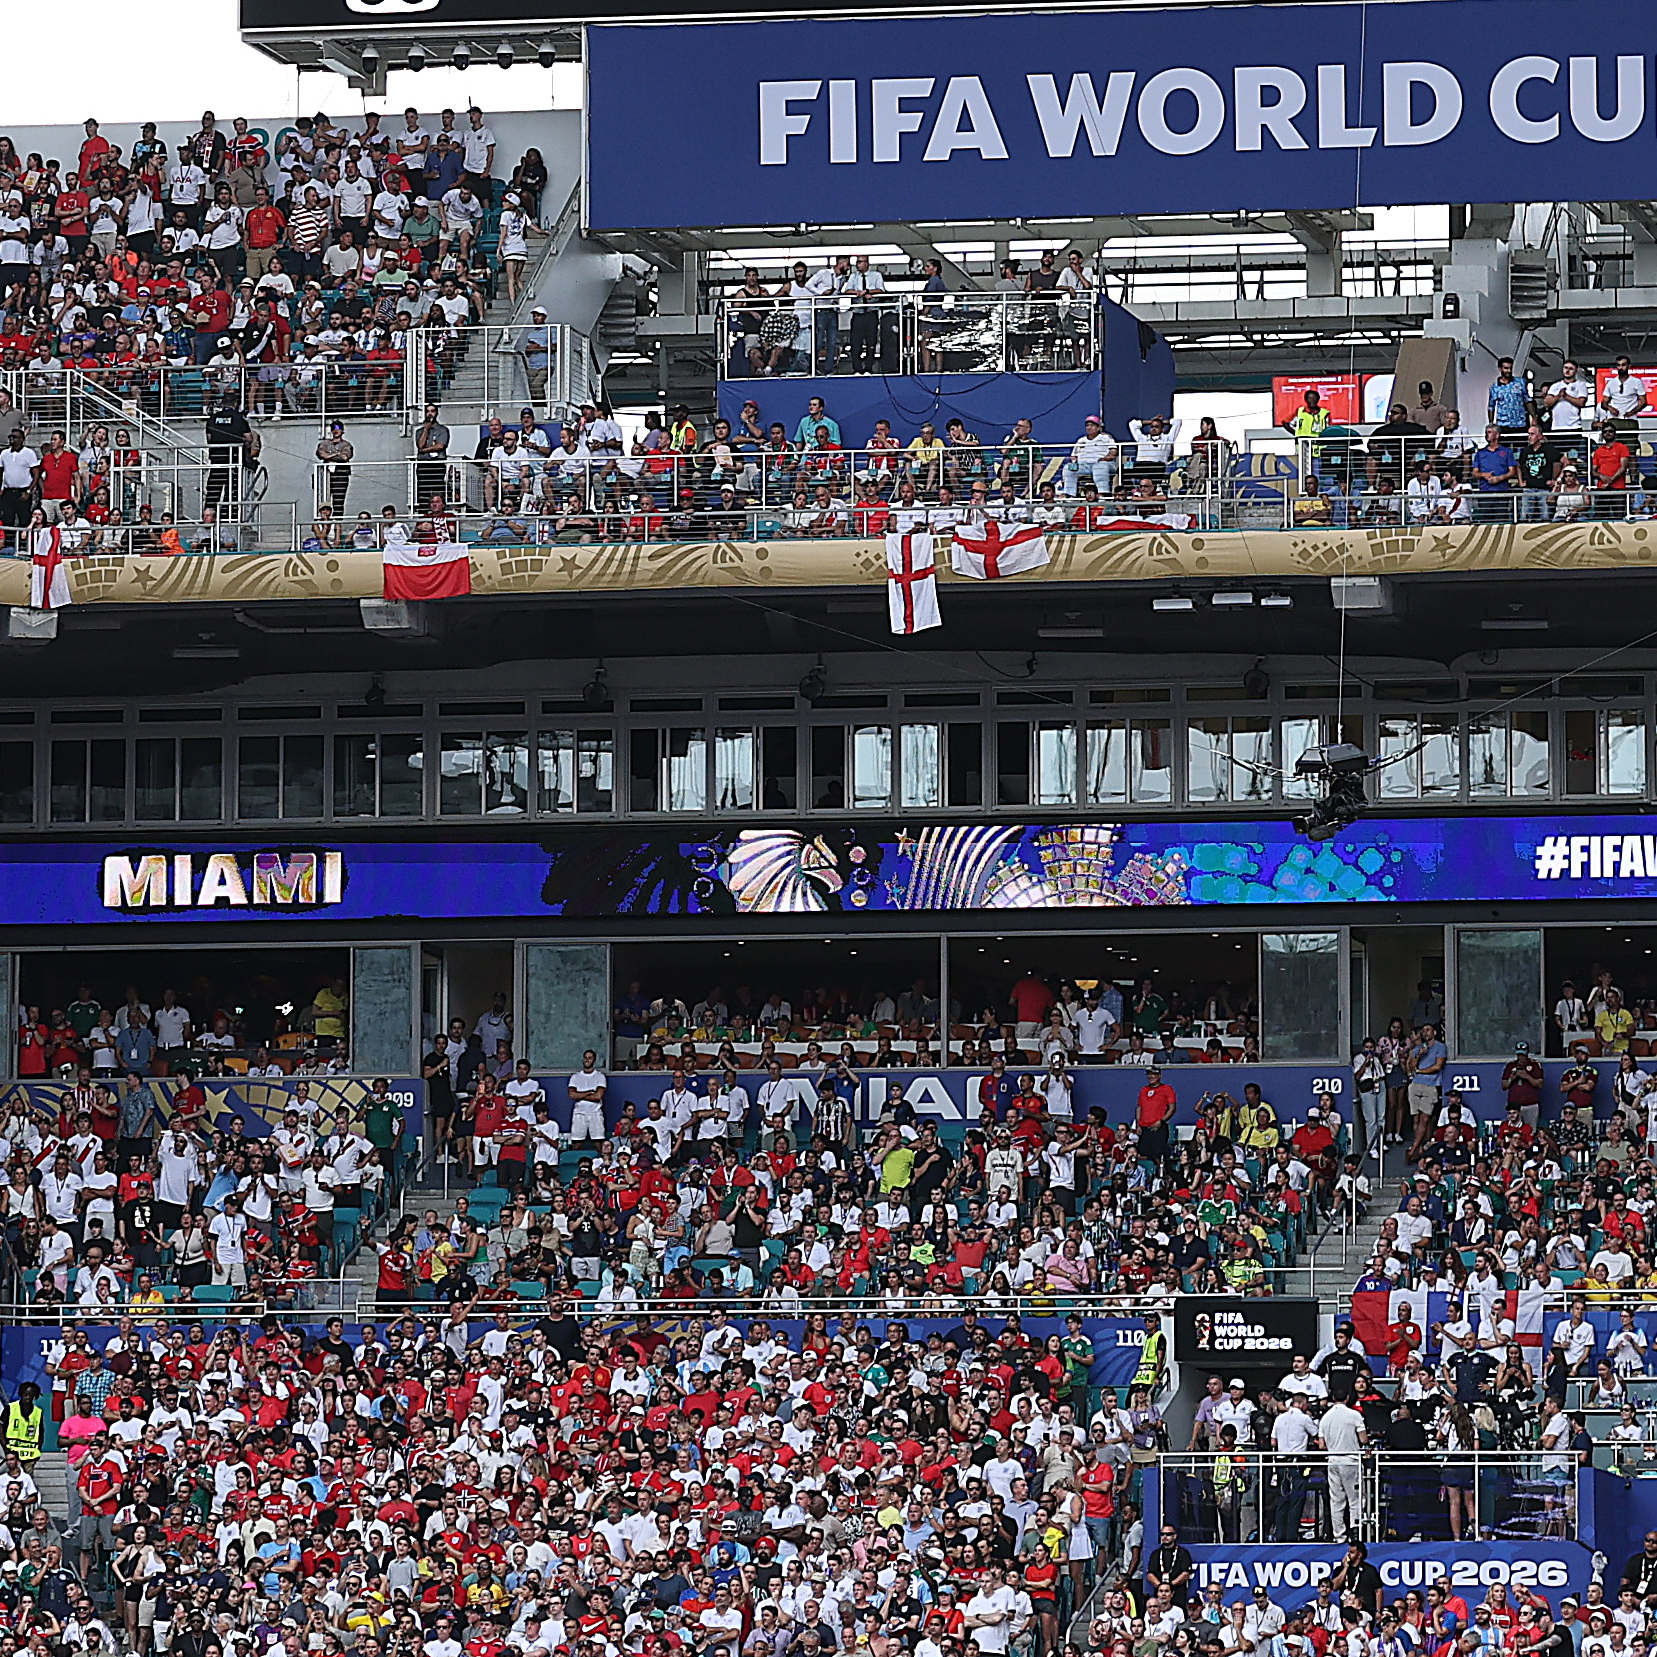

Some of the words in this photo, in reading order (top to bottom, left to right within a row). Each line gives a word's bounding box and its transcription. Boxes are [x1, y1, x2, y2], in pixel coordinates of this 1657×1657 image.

[759, 75, 1011, 166] FIFA
[1026, 61, 1464, 159] WORLD
[103, 851, 343, 909] MIAMI
[1312, 1078, 1342, 1094] 210
[1452, 1075, 1481, 1092] 211
[1213, 1312, 1245, 1324] FIFA
[1116, 1329, 1145, 1348] 110
[1213, 1324, 1265, 1338] WORLD
[1214, 1337, 1243, 1350] CUP
[1243, 1337, 1293, 1350] 2026
[1379, 1560, 1446, 1587] CUP
[1451, 1560, 1568, 1587] 2026
